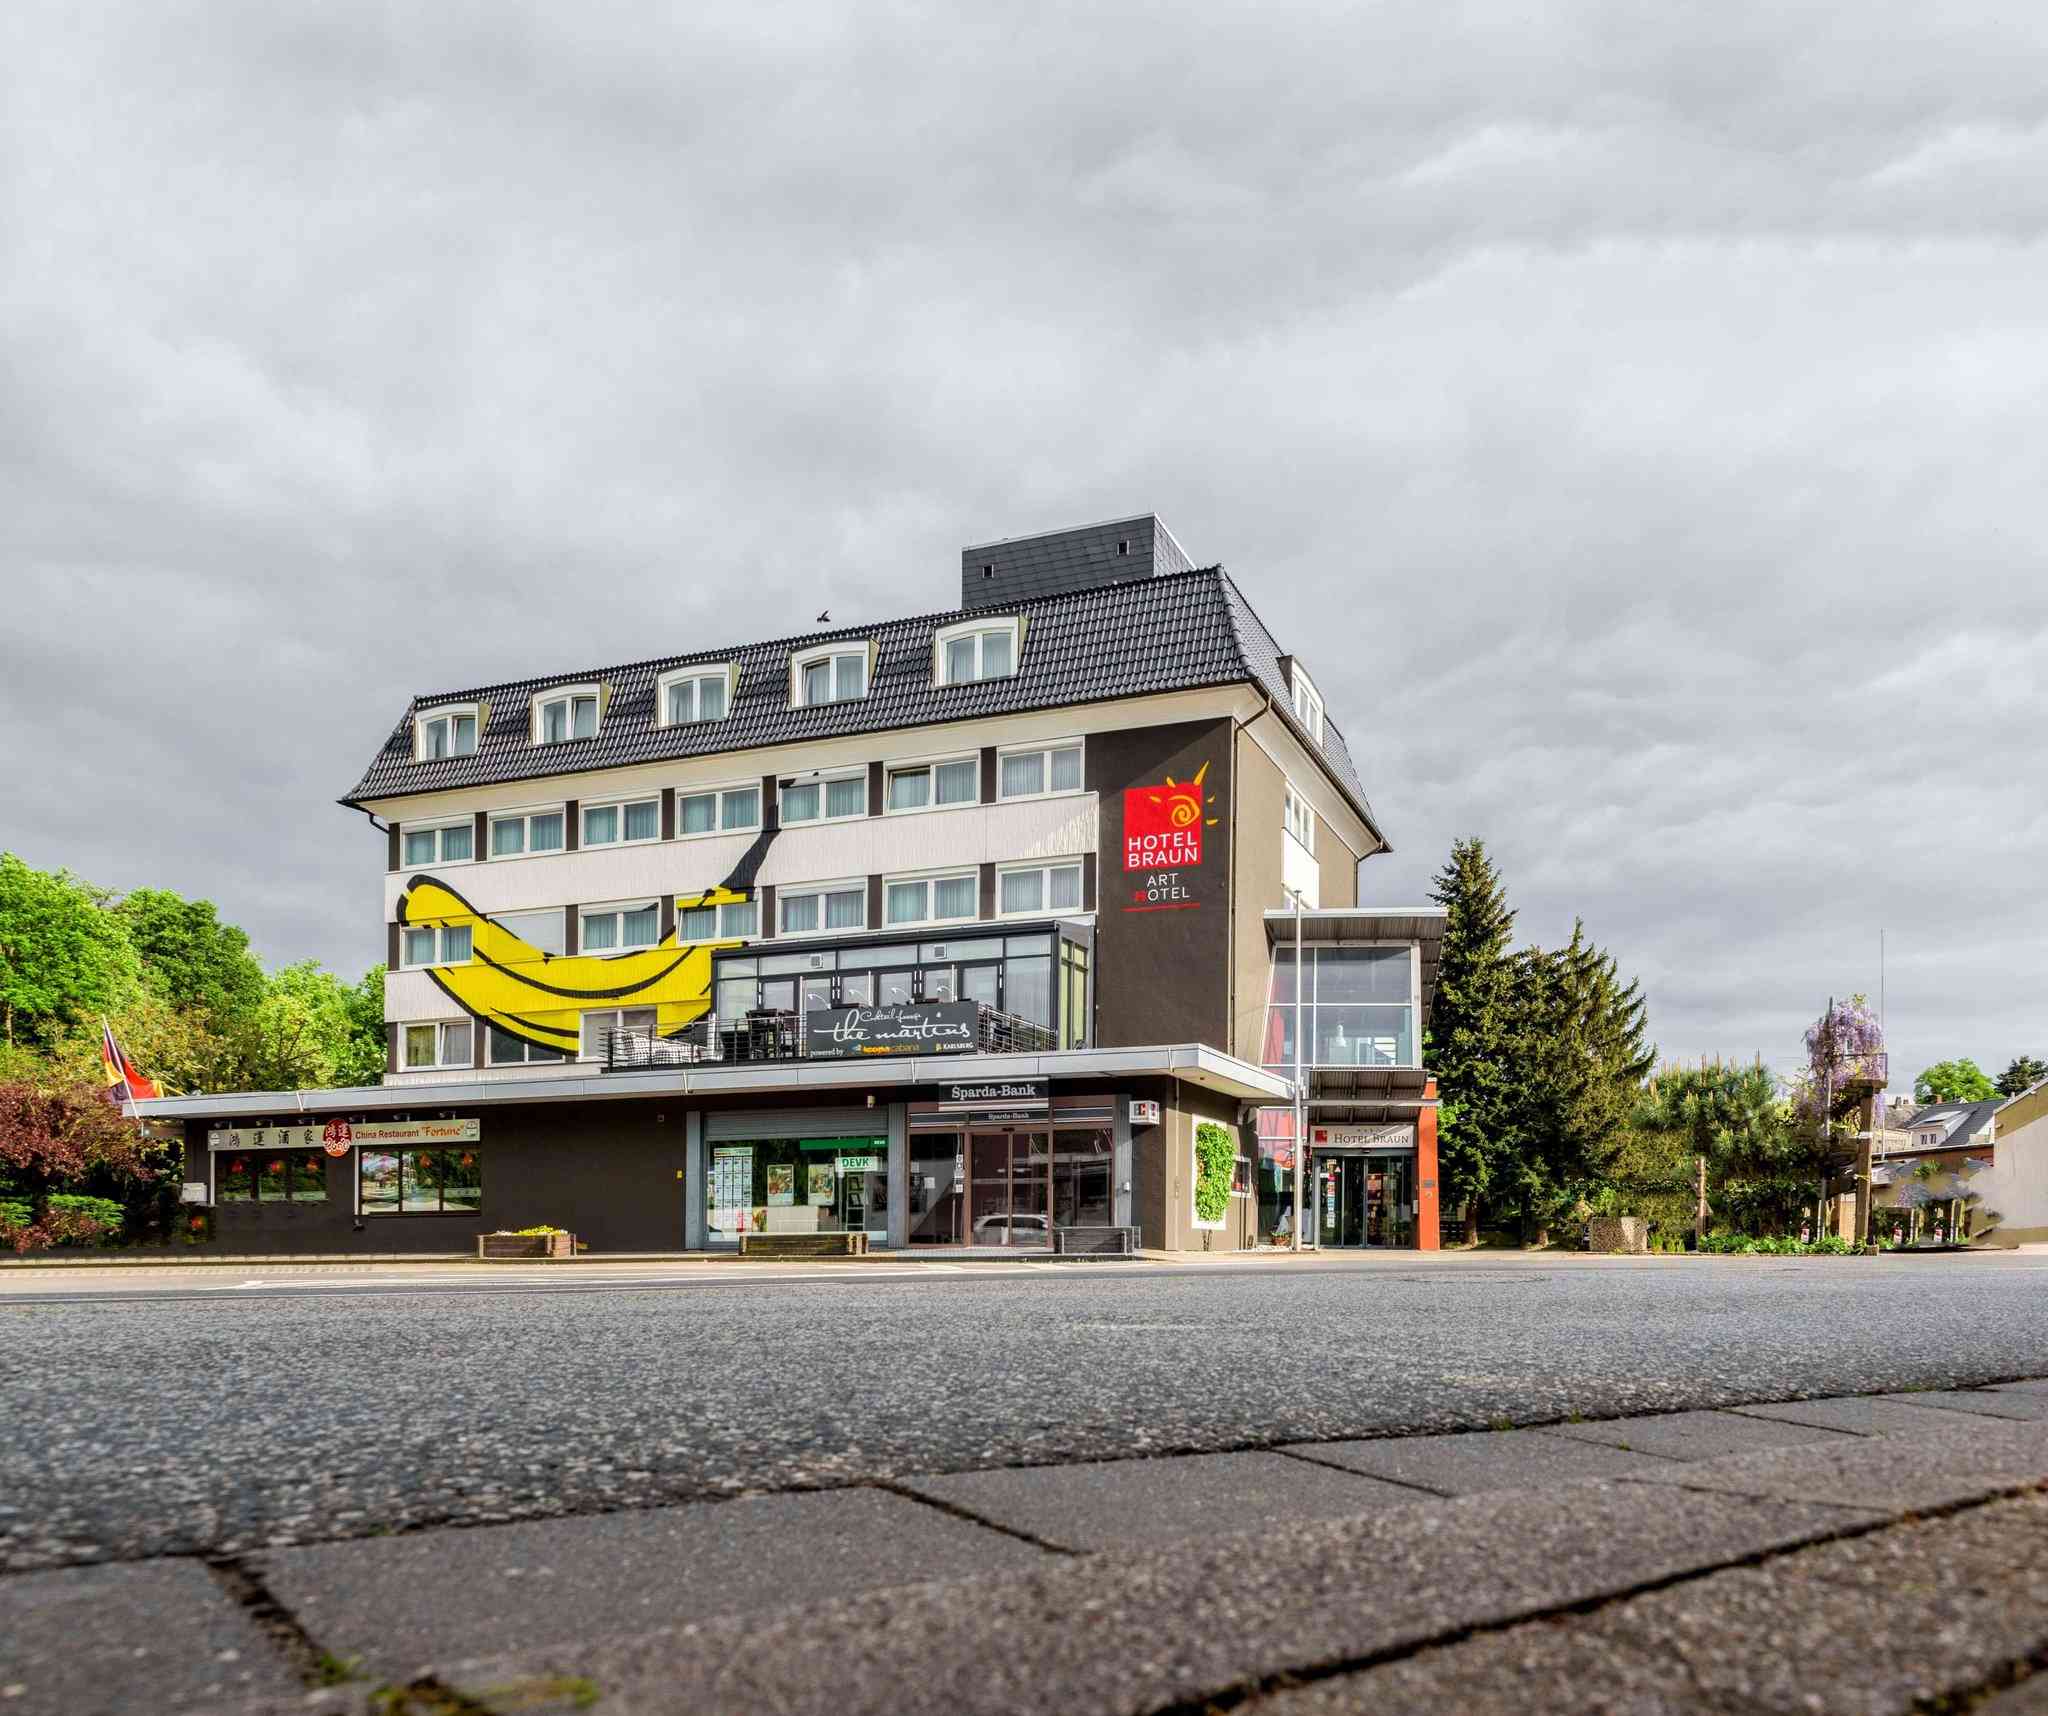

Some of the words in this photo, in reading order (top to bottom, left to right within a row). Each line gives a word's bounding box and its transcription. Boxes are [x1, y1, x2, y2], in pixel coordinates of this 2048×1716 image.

[1128, 831, 1197, 851] HOTEL
[1128, 847, 1197, 867] BRAUN
[1147, 873, 1178, 887] ART
[813, 1009, 869, 1042] the
[836, 1047, 844, 1057] by
[951, 1084, 1036, 1101] Sparda-Bank
[355, 1130, 377, 1139] China
[379, 1128, 419, 1138] Restaurant
[841, 1157, 870, 1168] DEVK
